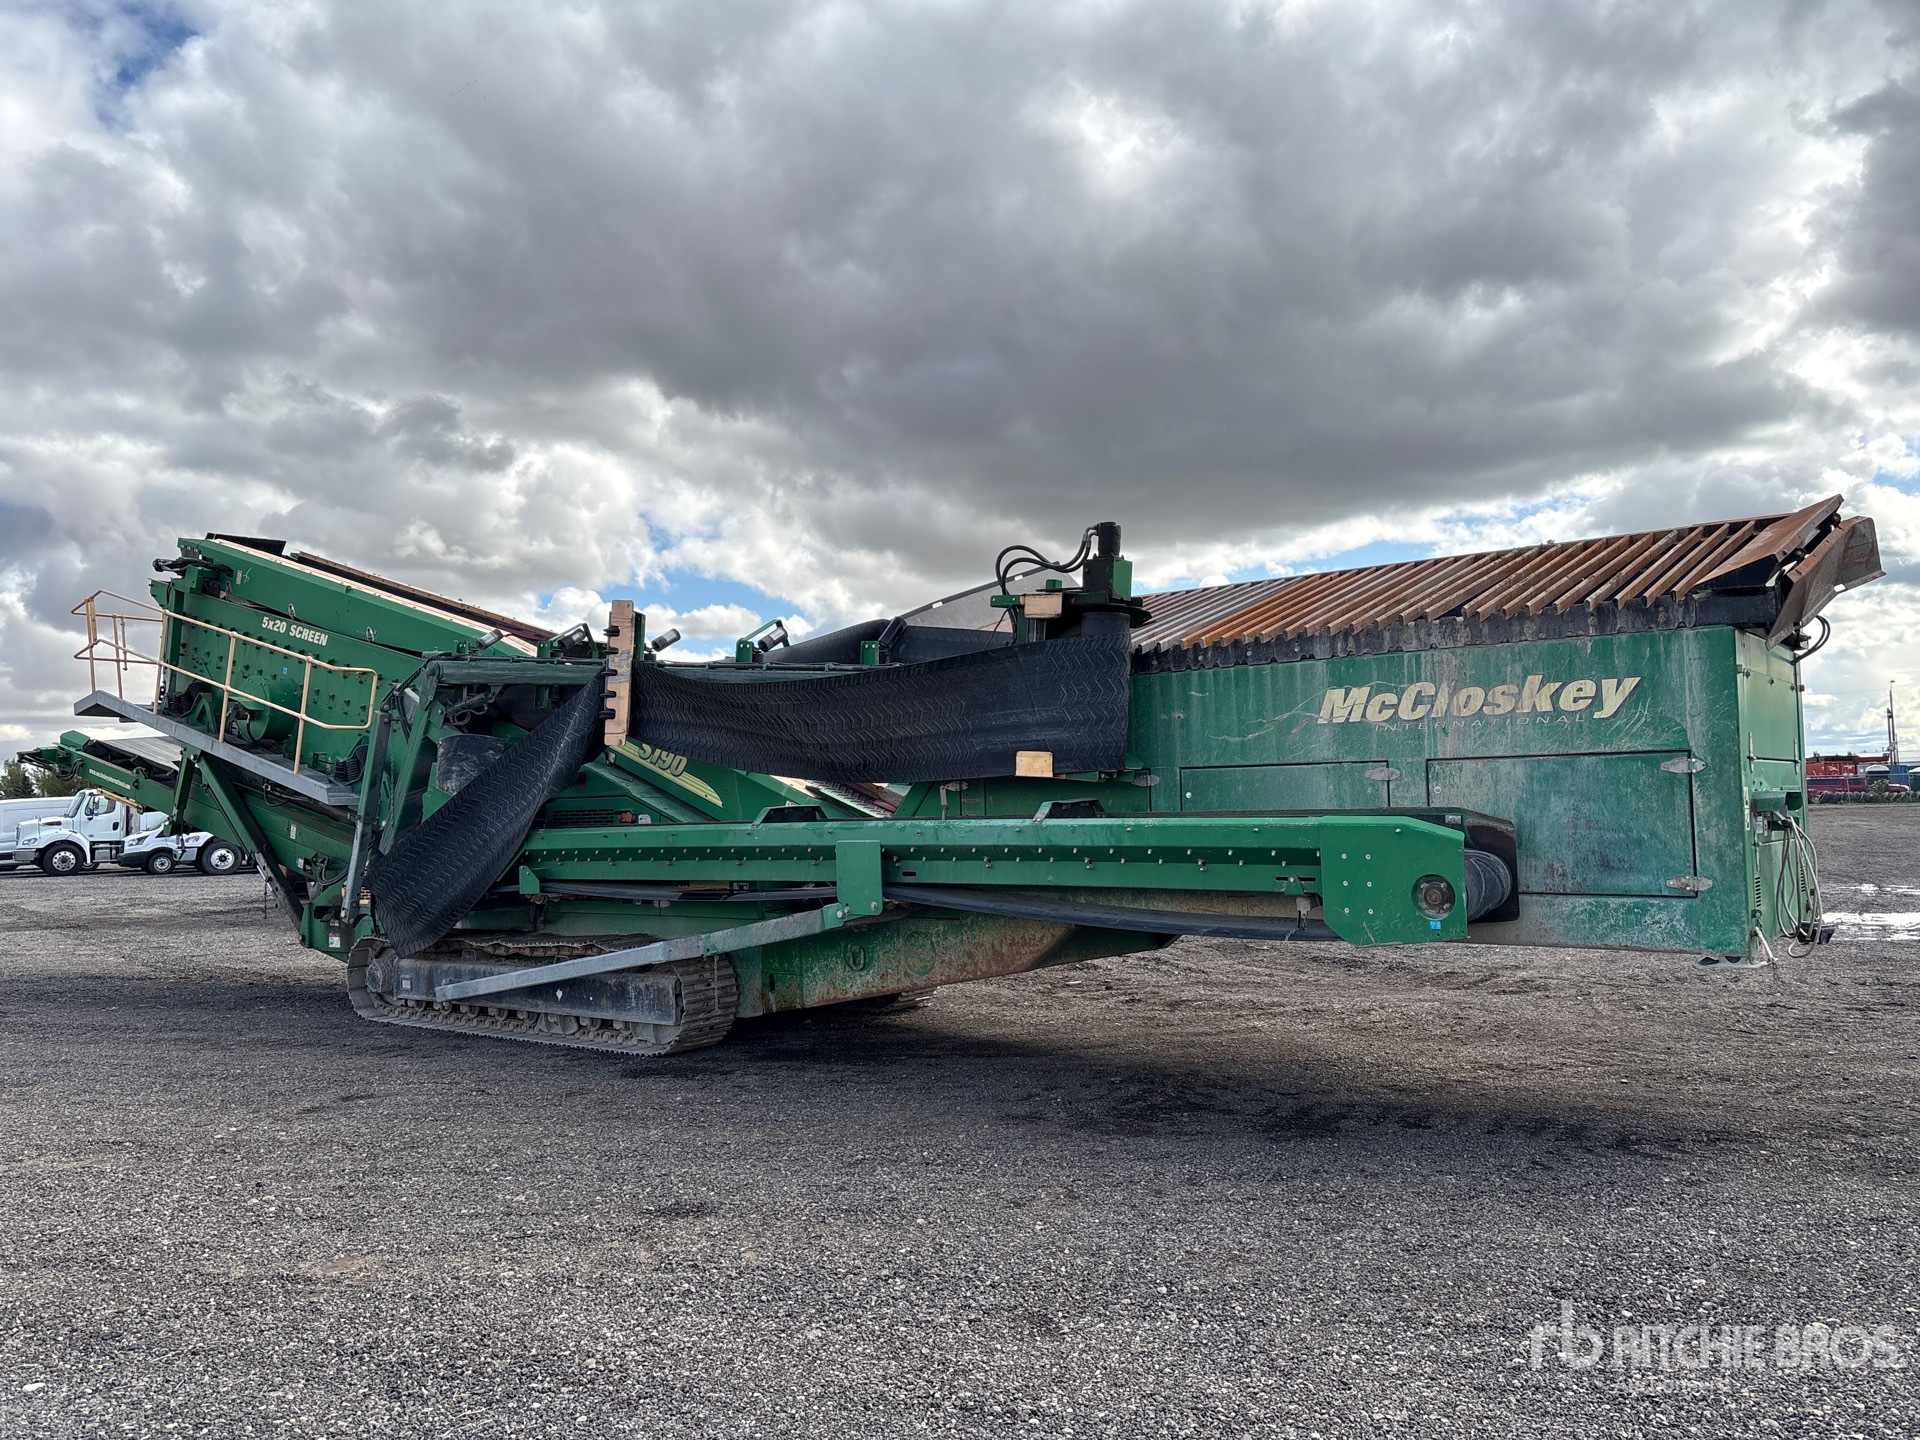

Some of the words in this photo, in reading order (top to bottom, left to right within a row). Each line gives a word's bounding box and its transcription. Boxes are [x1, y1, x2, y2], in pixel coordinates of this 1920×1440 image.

[262, 616, 287, 634] 5x20
[289, 624, 329, 647] SCREEN
[1317, 674, 1643, 724] McCloskey
[1375, 714, 1586, 732] INTERNATIONAL
